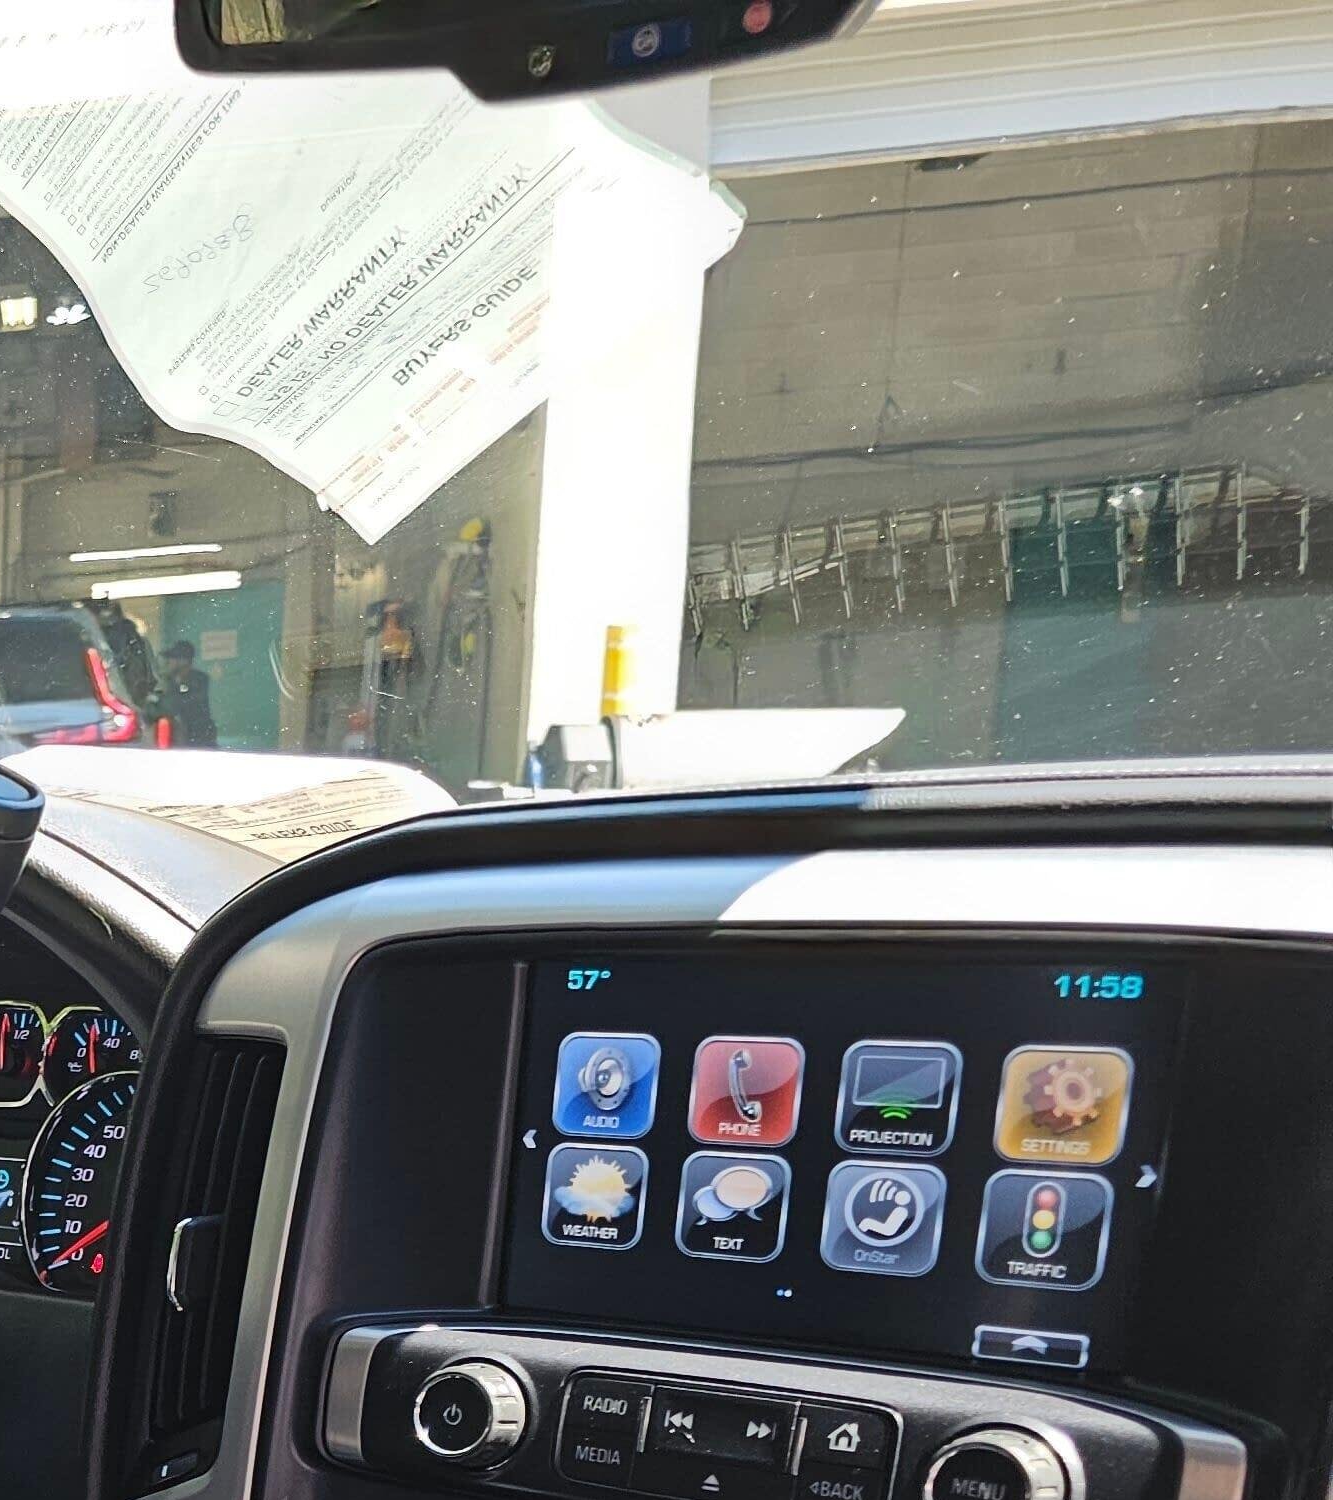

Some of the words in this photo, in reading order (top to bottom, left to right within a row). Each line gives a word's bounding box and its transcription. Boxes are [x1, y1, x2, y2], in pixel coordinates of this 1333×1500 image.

[1053, 974, 1144, 999] 11:58
[13, 1029, 30, 1040] 1/2
[102, 1038, 121, 1049] 40
[76, 1048, 86, 1058] 0
[582, 1115, 620, 1130] AUDIO
[717, 1122, 762, 1137] PHONE
[102, 1125, 126, 1140] 50
[848, 1128, 934, 1147] PROJECTION
[83, 1144, 107, 1159] 40
[1019, 1137, 1092, 1155] SETTINGS
[71, 1168, 95, 1182] 30
[64, 1194, 88, 1208] 20
[64, 1219, 83, 1234] 10
[562, 1223, 619, 1241] WEATHER
[712, 1235, 744, 1252] TEXT
[853, 1248, 901, 1266] OnStar
[1005, 1260, 1068, 1280] TRAFFIC
[582, 1394, 628, 1416] RADIO
[574, 1444, 621, 1466] MEDIA
